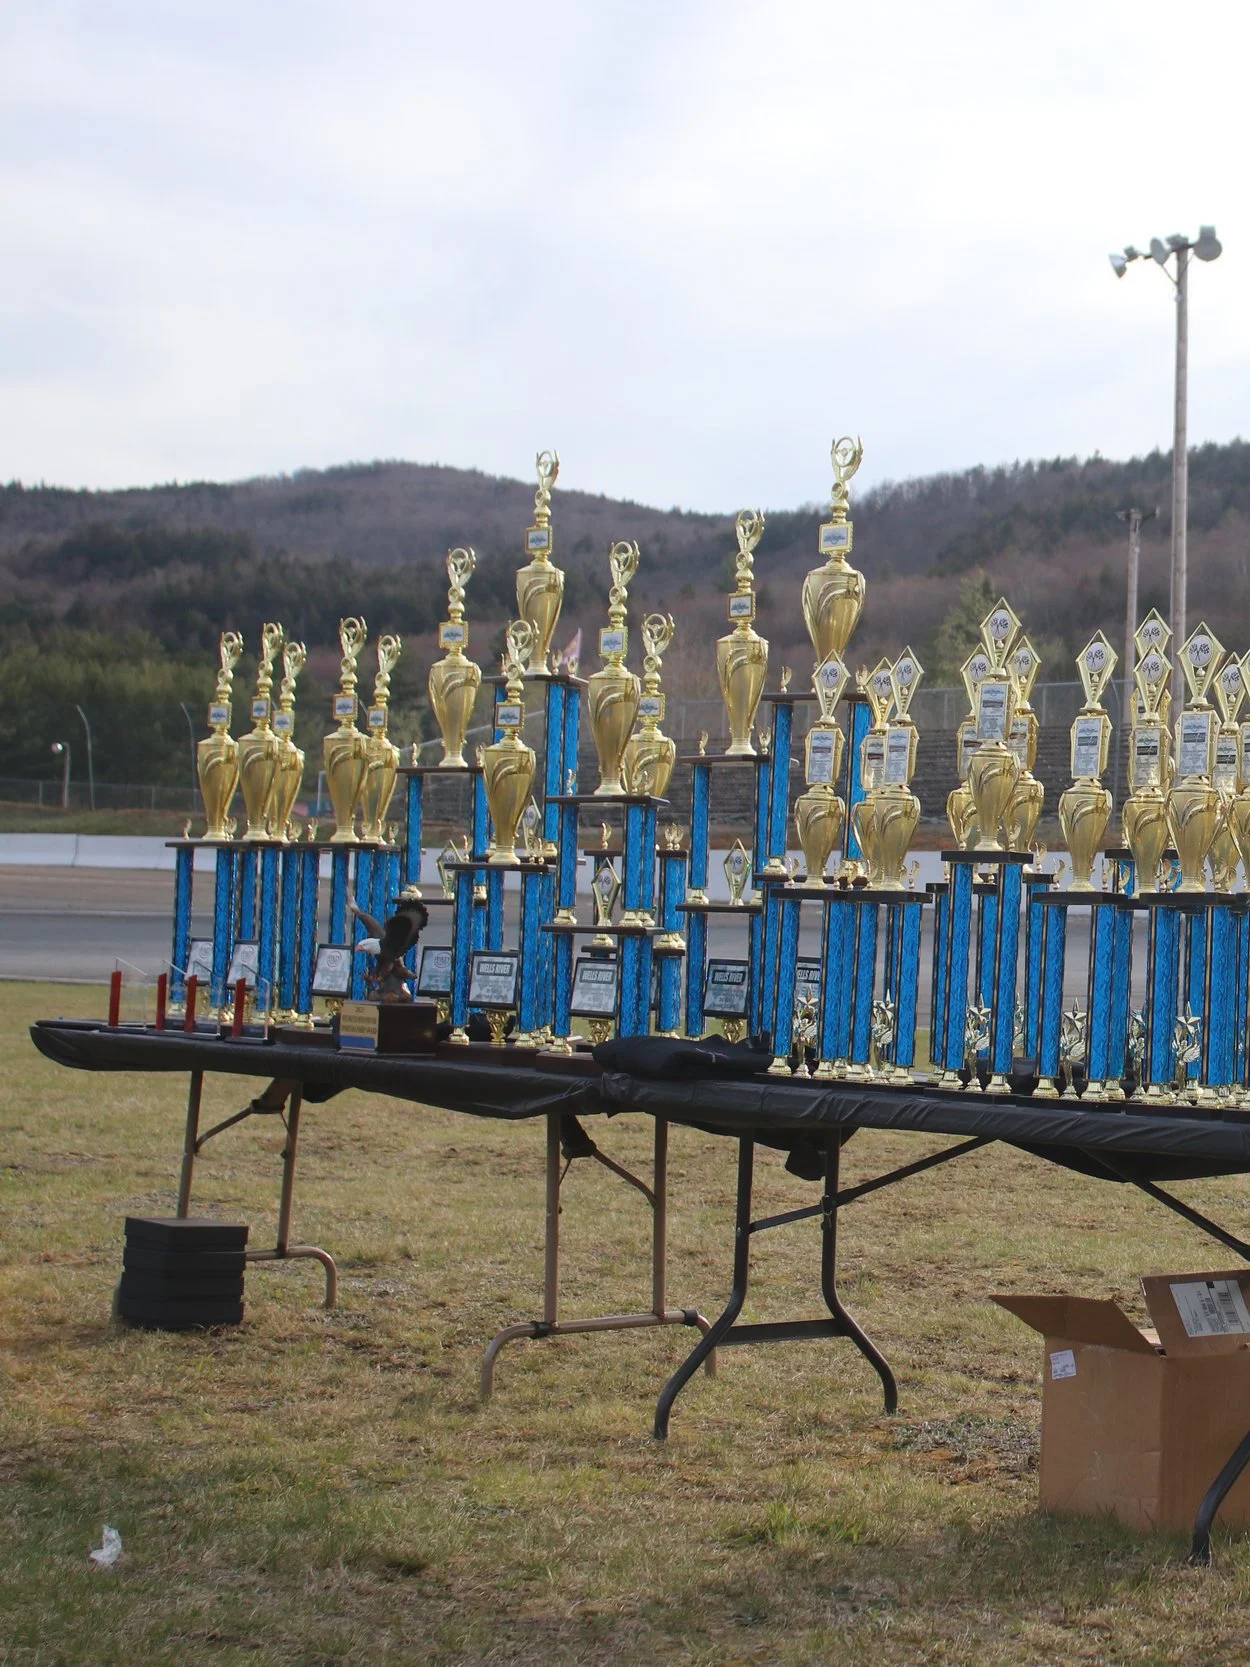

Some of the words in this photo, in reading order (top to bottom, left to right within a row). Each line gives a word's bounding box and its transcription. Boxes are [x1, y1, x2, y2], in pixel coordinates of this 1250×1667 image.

[479, 963, 496, 973] WELLS
[495, 964, 511, 974] RIVER
[582, 970, 598, 981] WELLS
[597, 971, 613, 982] RIVER
[713, 971, 730, 982] WELLS
[728, 972, 744, 983] RIVER
